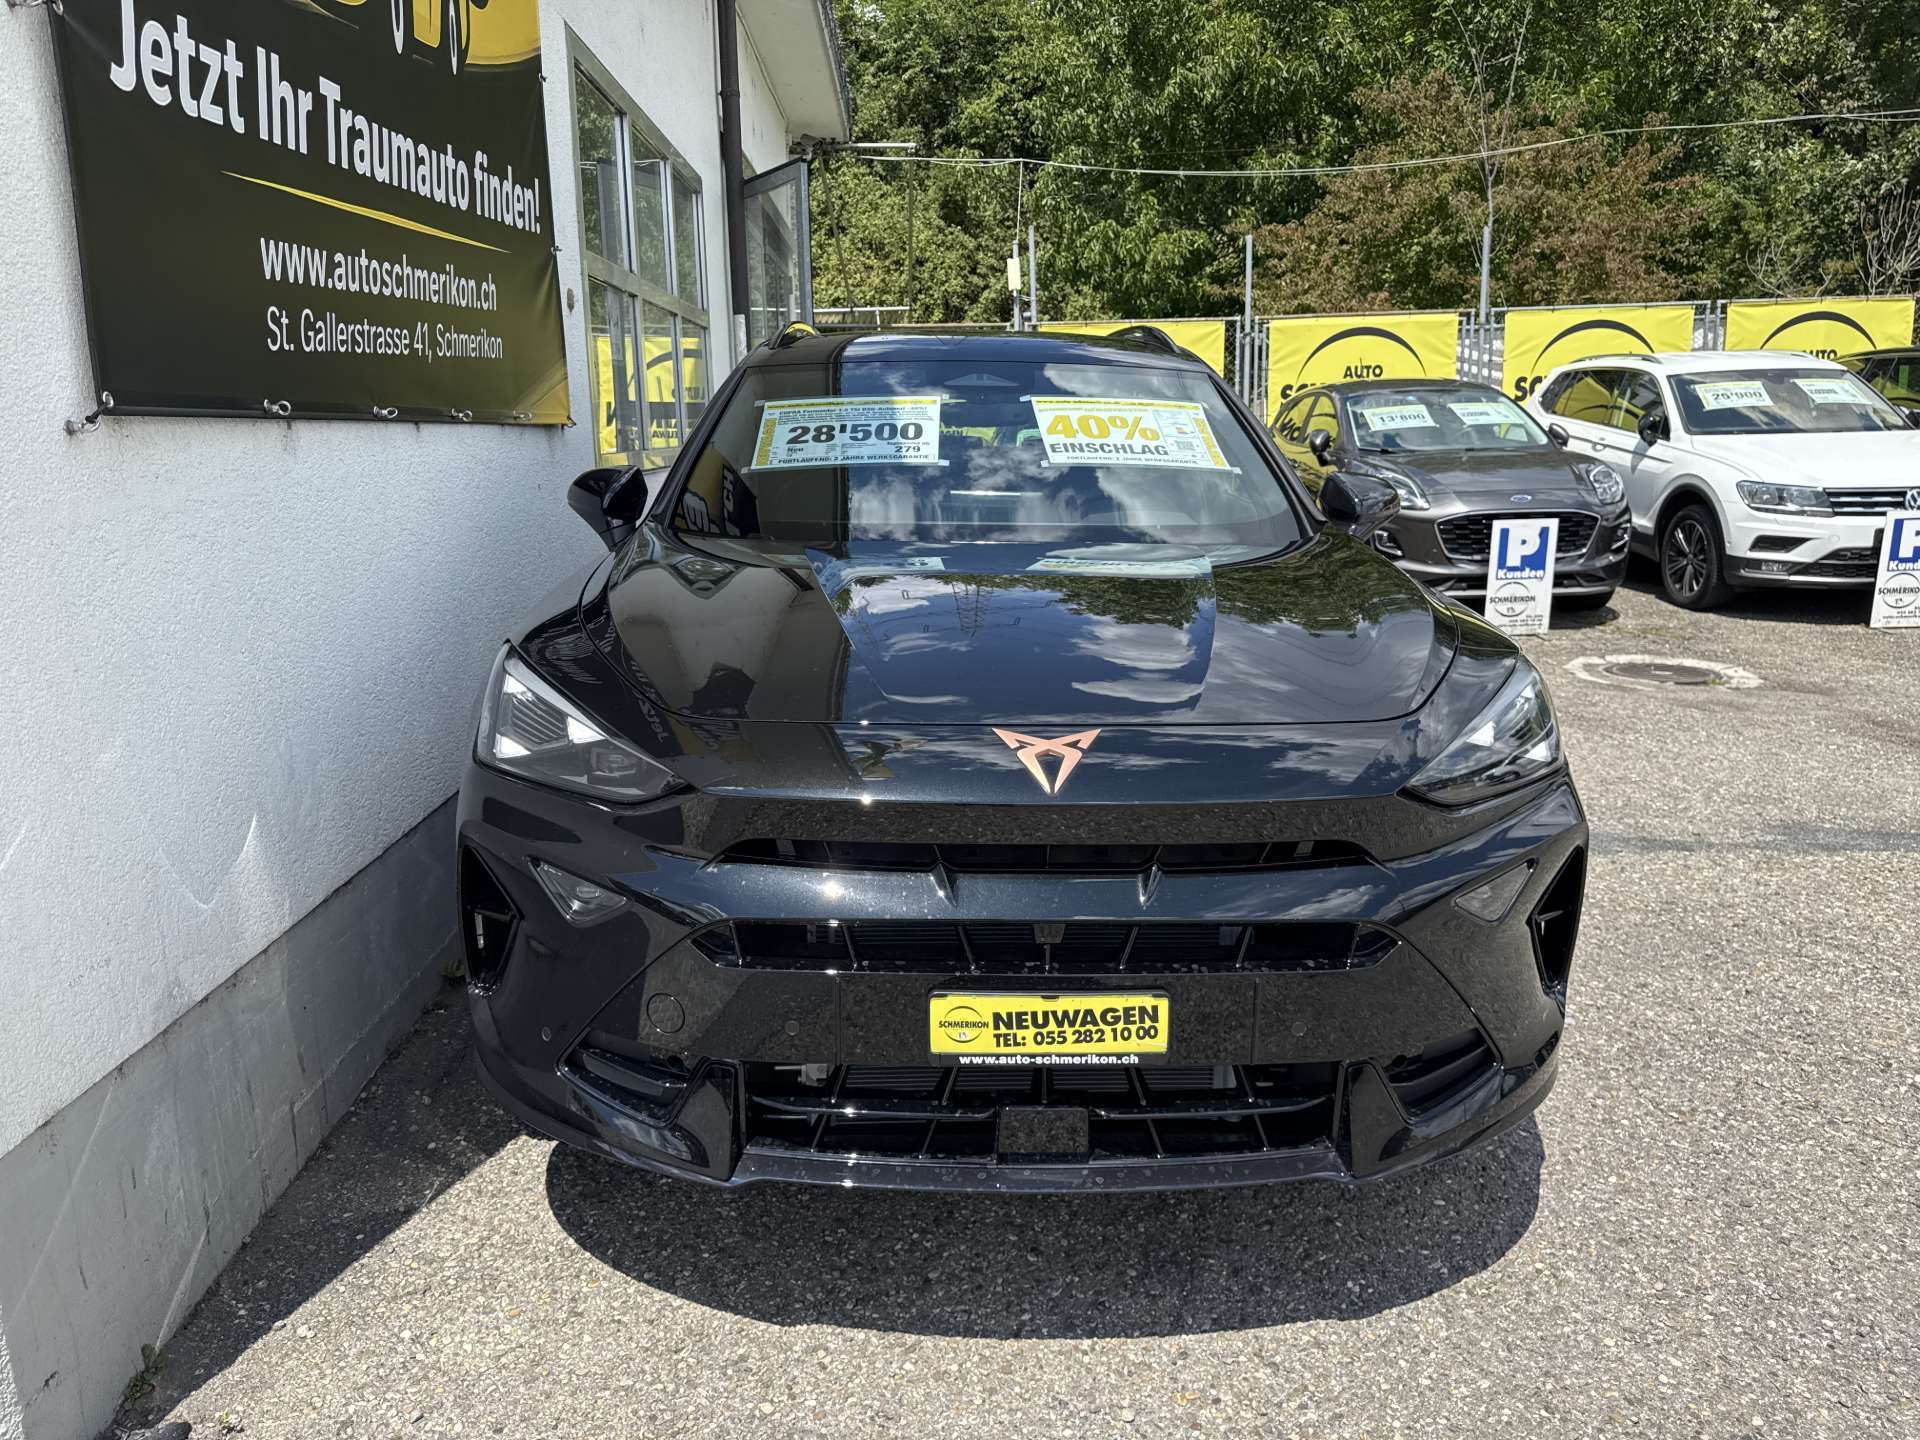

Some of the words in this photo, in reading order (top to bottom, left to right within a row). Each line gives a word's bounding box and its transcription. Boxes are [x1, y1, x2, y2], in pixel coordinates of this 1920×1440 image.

[110, 0, 245, 134] Jetzt
[256, 45, 312, 155] Ihr
[319, 75, 470, 211] Traumauto
[474, 150, 541, 234] finden!
[260, 237, 497, 311] www.autoschmerikon.ch
[267, 305, 295, 351] St.
[300, 308, 410, 355] Gallerstrasse
[413, 321, 432, 363] 41,
[436, 323, 503, 360] Schmerikon
[1343, 365, 1384, 379] AUTO
[786, 422, 923, 445] 28'500
[1046, 414, 1161, 442] 40%
[1050, 442, 1170, 456] EINSCHLAG
[1497, 567, 1545, 580] Kunden
[1489, 595, 1536, 604] SCHMERIKON
[938, 1020, 990, 1029] SCHMERIKON
[992, 1005, 1160, 1031] NEUWAGEN
[993, 1033, 1026, 1048] TEL:
[1033, 1031, 1068, 1046] 055
[1072, 1028, 1105, 1045] 282
[1111, 1026, 1131, 1042] 10
[1135, 1025, 1159, 1041] 00
[959, 1054, 1139, 1065] www.auto-schmerikon.ch
